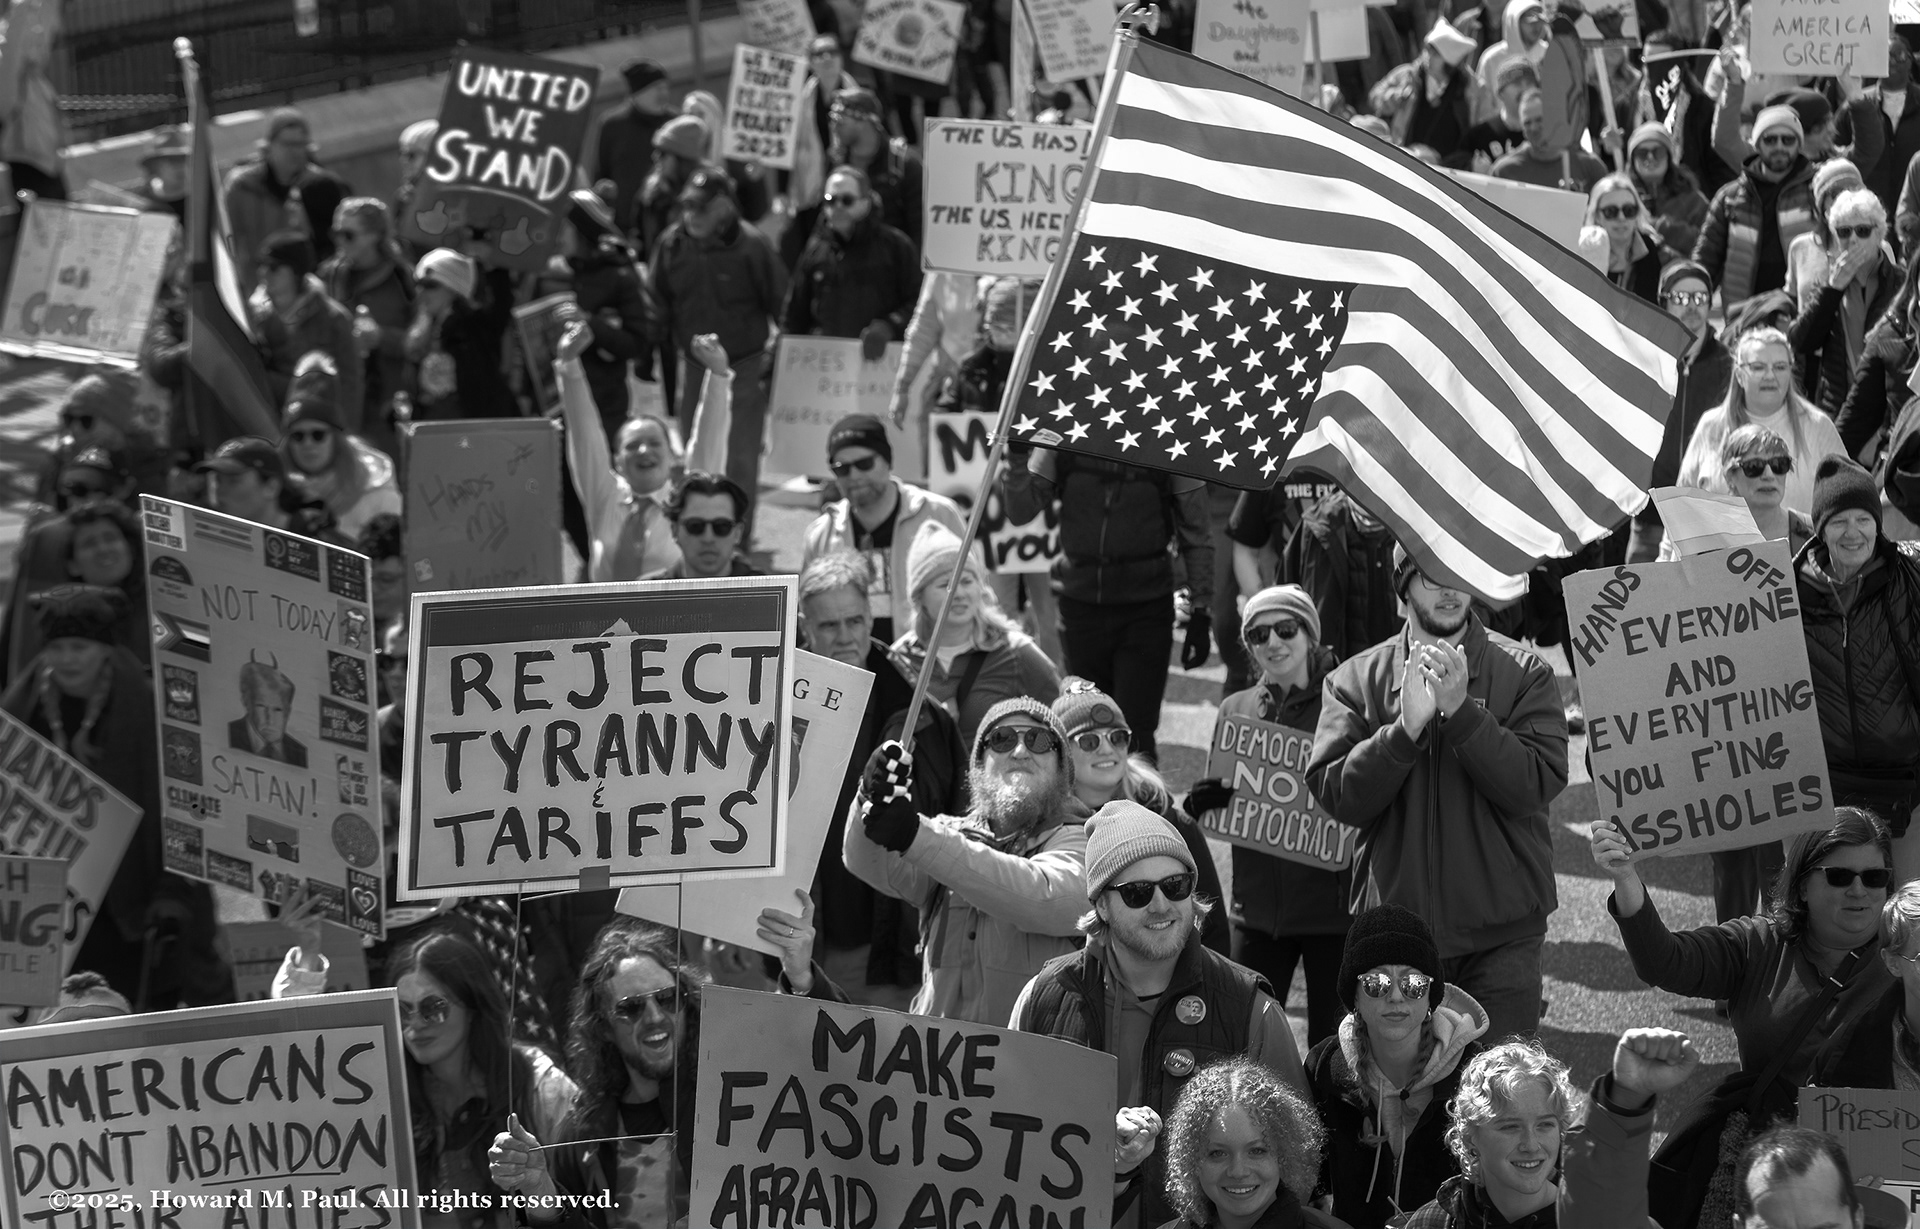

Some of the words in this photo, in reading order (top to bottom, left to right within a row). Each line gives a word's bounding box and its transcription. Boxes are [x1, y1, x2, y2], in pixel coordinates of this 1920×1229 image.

[1772, 14, 1871, 37] AMERICA
[1782, 41, 1861, 67] GREAT
[458, 61, 590, 113] UNITED
[485, 104, 544, 144] WE
[941, 127, 985, 144] THE
[1032, 131, 1078, 153] HAS
[425, 128, 572, 200] STAND
[930, 204, 974, 224] THE
[1284, 483, 1313, 499] THE
[201, 584, 259, 621] NOT
[271, 594, 336, 641] TODAY
[1571, 565, 1641, 667] HANDS
[1726, 548, 1786, 590] OFF
[1620, 586, 1799, 656] EVERYONE
[449, 638, 780, 715] REJECT
[1664, 654, 1736, 698] AND
[1588, 679, 1813, 753] EVERYTHING
[430, 710, 774, 794] TYRANNY
[1220, 720, 1314, 772] DEMOCR
[1691, 731, 1790, 783] F'ING
[211, 755, 318, 818] SATAN!
[433, 790, 758, 867] TARIFFS
[350, 872, 378, 889] LOVE
[352, 917, 378, 934] LOVE
[7, 1034, 375, 1129] AMERICANS
[812, 1006, 1000, 1100] MAKE
[1169, 1051, 1193, 1066] FEMINIST
[167, 1113, 387, 1184] ABANDON
[716, 1070, 1091, 1199] FASCISTS
[709, 1163, 877, 1229] AFRAID
